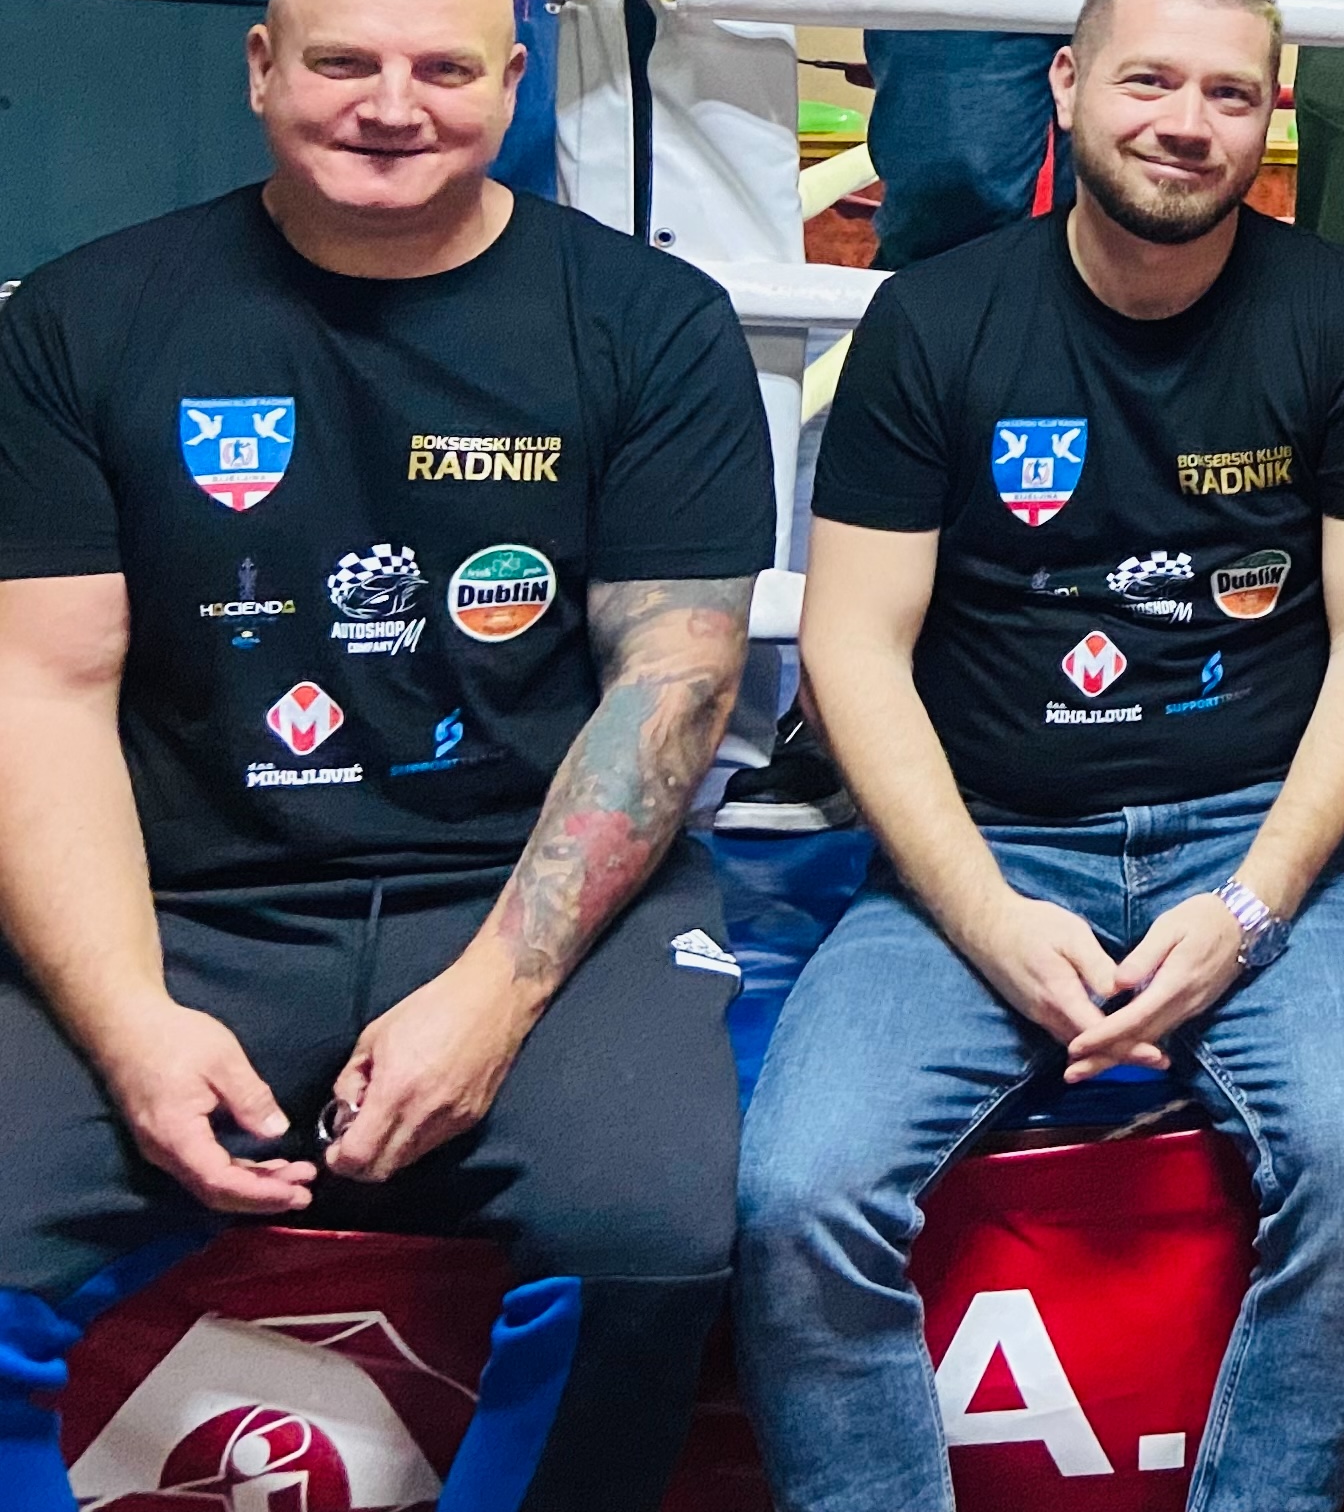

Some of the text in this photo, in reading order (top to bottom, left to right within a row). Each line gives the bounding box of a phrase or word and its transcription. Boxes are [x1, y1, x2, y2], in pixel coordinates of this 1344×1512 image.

[411, 435, 562, 451] BOKSERSKI KLUB
[407, 450, 561, 482] RADNIK
[1177, 445, 1293, 469] BOKSERSKI KLUB
[1178, 458, 1293, 495] RADNIK
[200, 599, 296, 617] HACIENDA
[330, 620, 406, 640] AUTOSHOP
[1045, 704, 1142, 724] MIHAJLOVIĆ
[247, 763, 364, 788] MIHAJLOVIĆ
